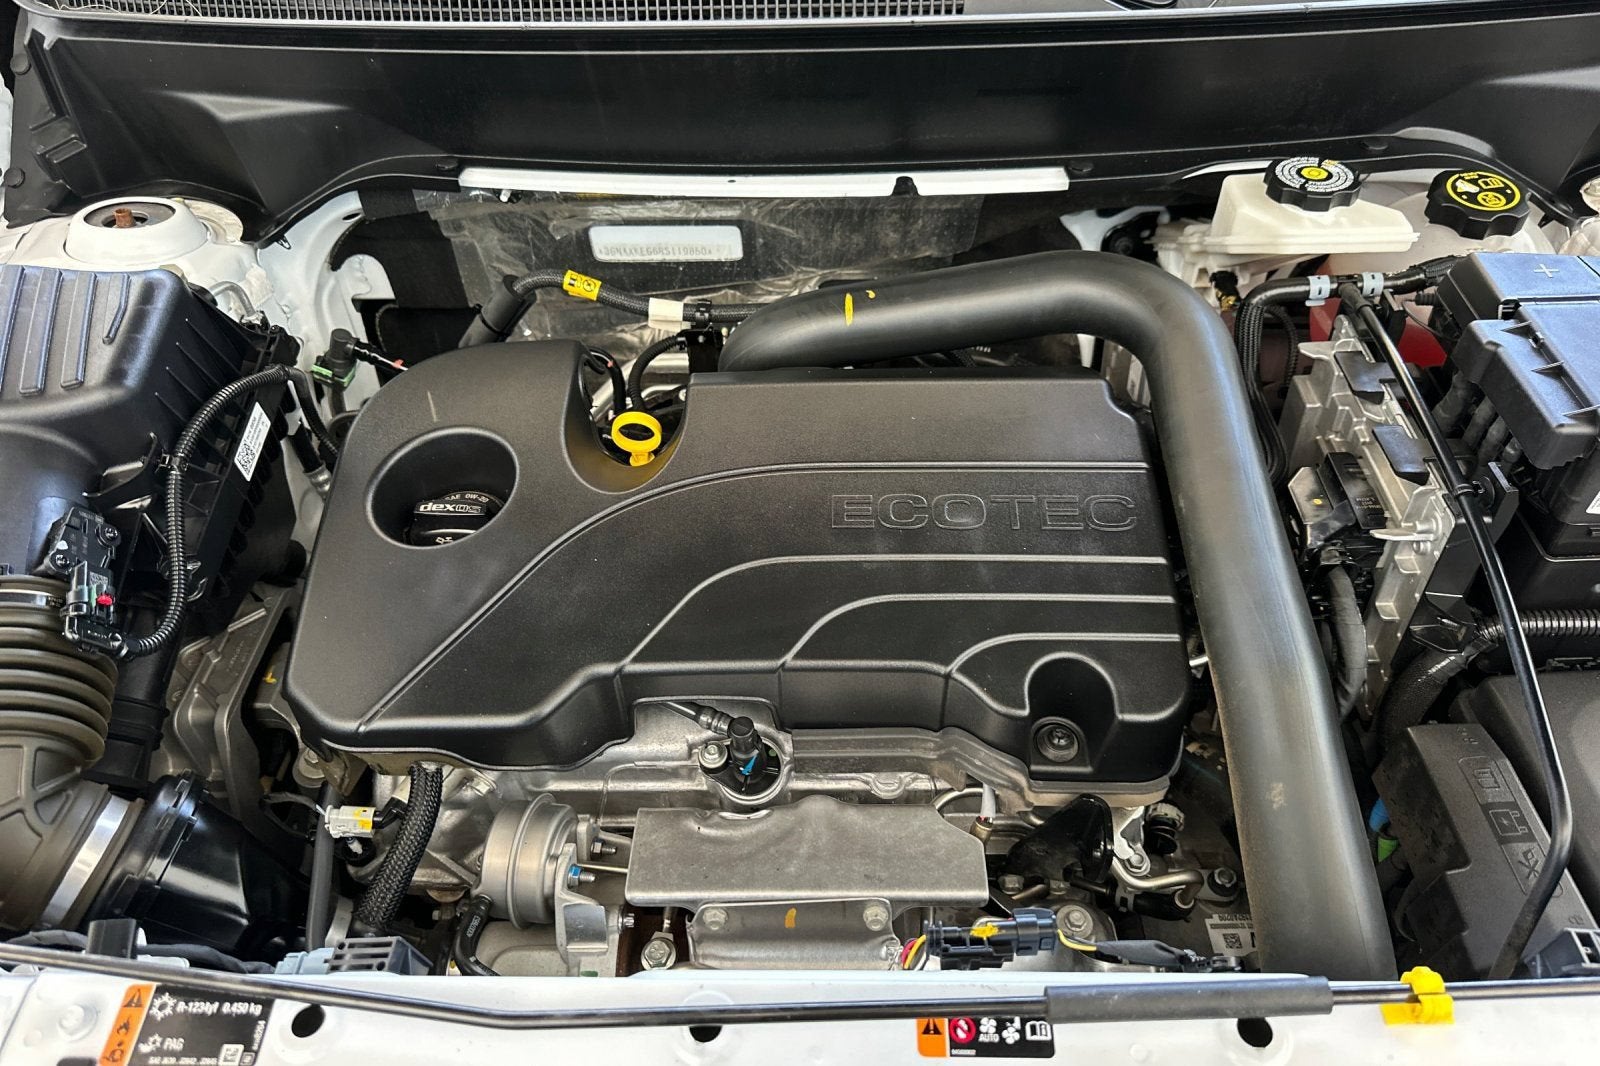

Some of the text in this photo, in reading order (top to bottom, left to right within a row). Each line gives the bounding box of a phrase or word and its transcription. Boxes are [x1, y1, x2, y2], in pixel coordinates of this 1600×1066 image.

[420, 502, 481, 513] dexos
[831, 493, 1137, 531] ECOTEC
[249, 1002, 263, 1016] kg
[163, 1037, 185, 1050] PAG
[978, 1033, 1000, 1042] AUTO
